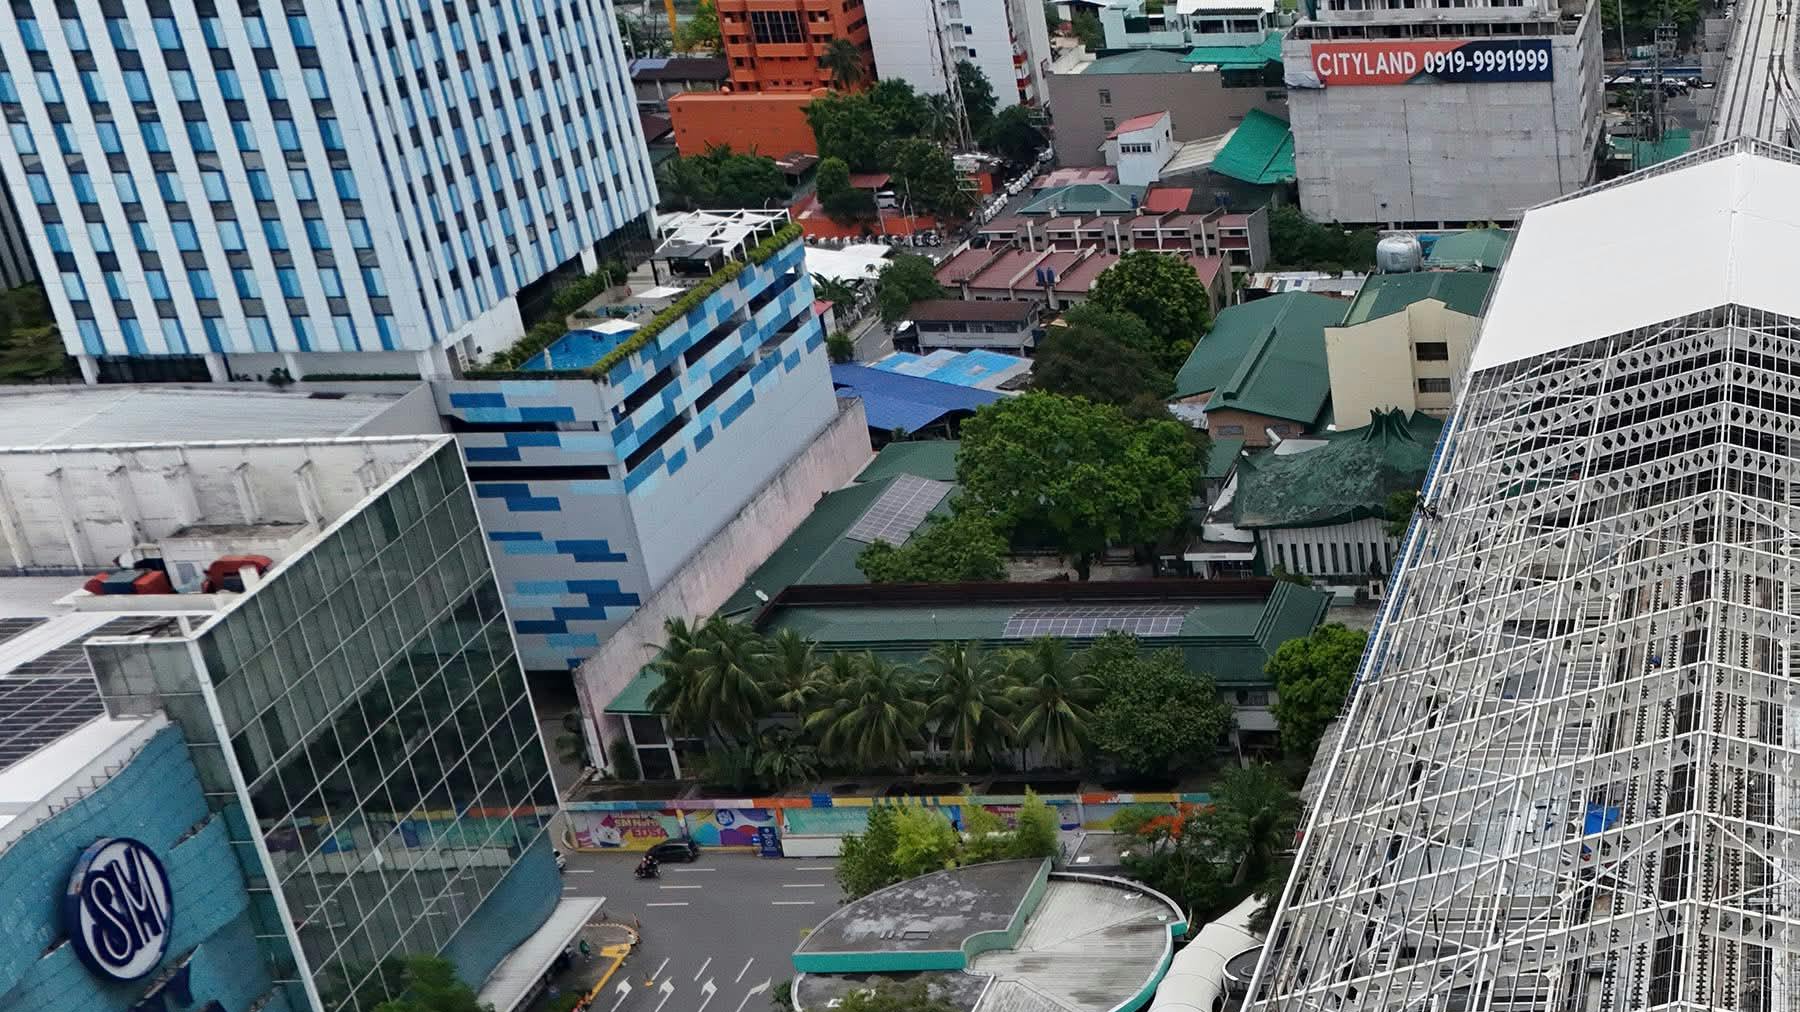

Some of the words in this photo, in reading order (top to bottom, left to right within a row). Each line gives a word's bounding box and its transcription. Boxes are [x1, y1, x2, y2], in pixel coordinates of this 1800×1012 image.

[1317, 52, 1416, 76] CITYLAND
[1424, 49, 1549, 73] 0919-9991999
[84, 846, 165, 966] SM
